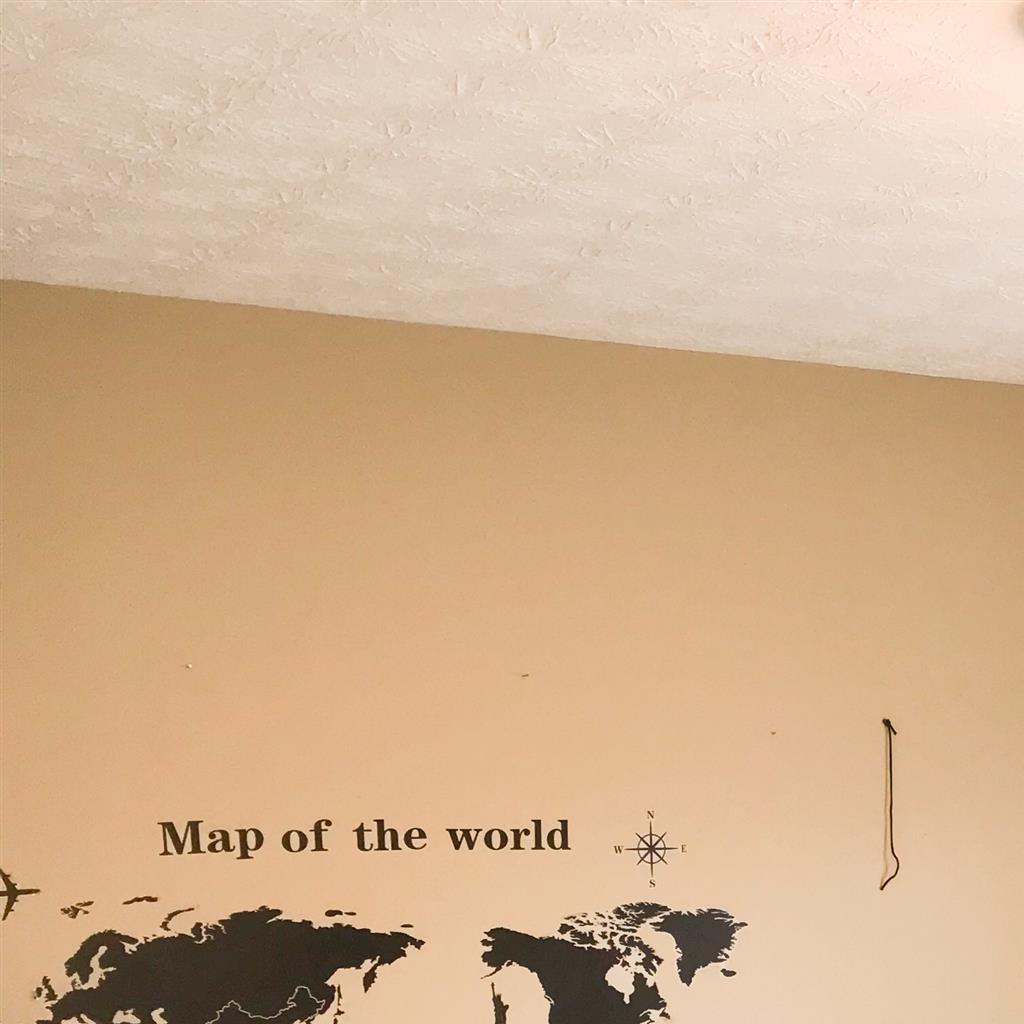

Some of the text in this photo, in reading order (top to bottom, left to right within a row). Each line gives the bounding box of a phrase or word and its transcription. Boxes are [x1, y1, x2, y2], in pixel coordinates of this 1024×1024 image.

[647, 810, 655, 819] N
[157, 818, 572, 860] Map of the world
[613, 845, 624, 854] W
[681, 844, 687, 853] E
[648, 879, 656, 888] S
